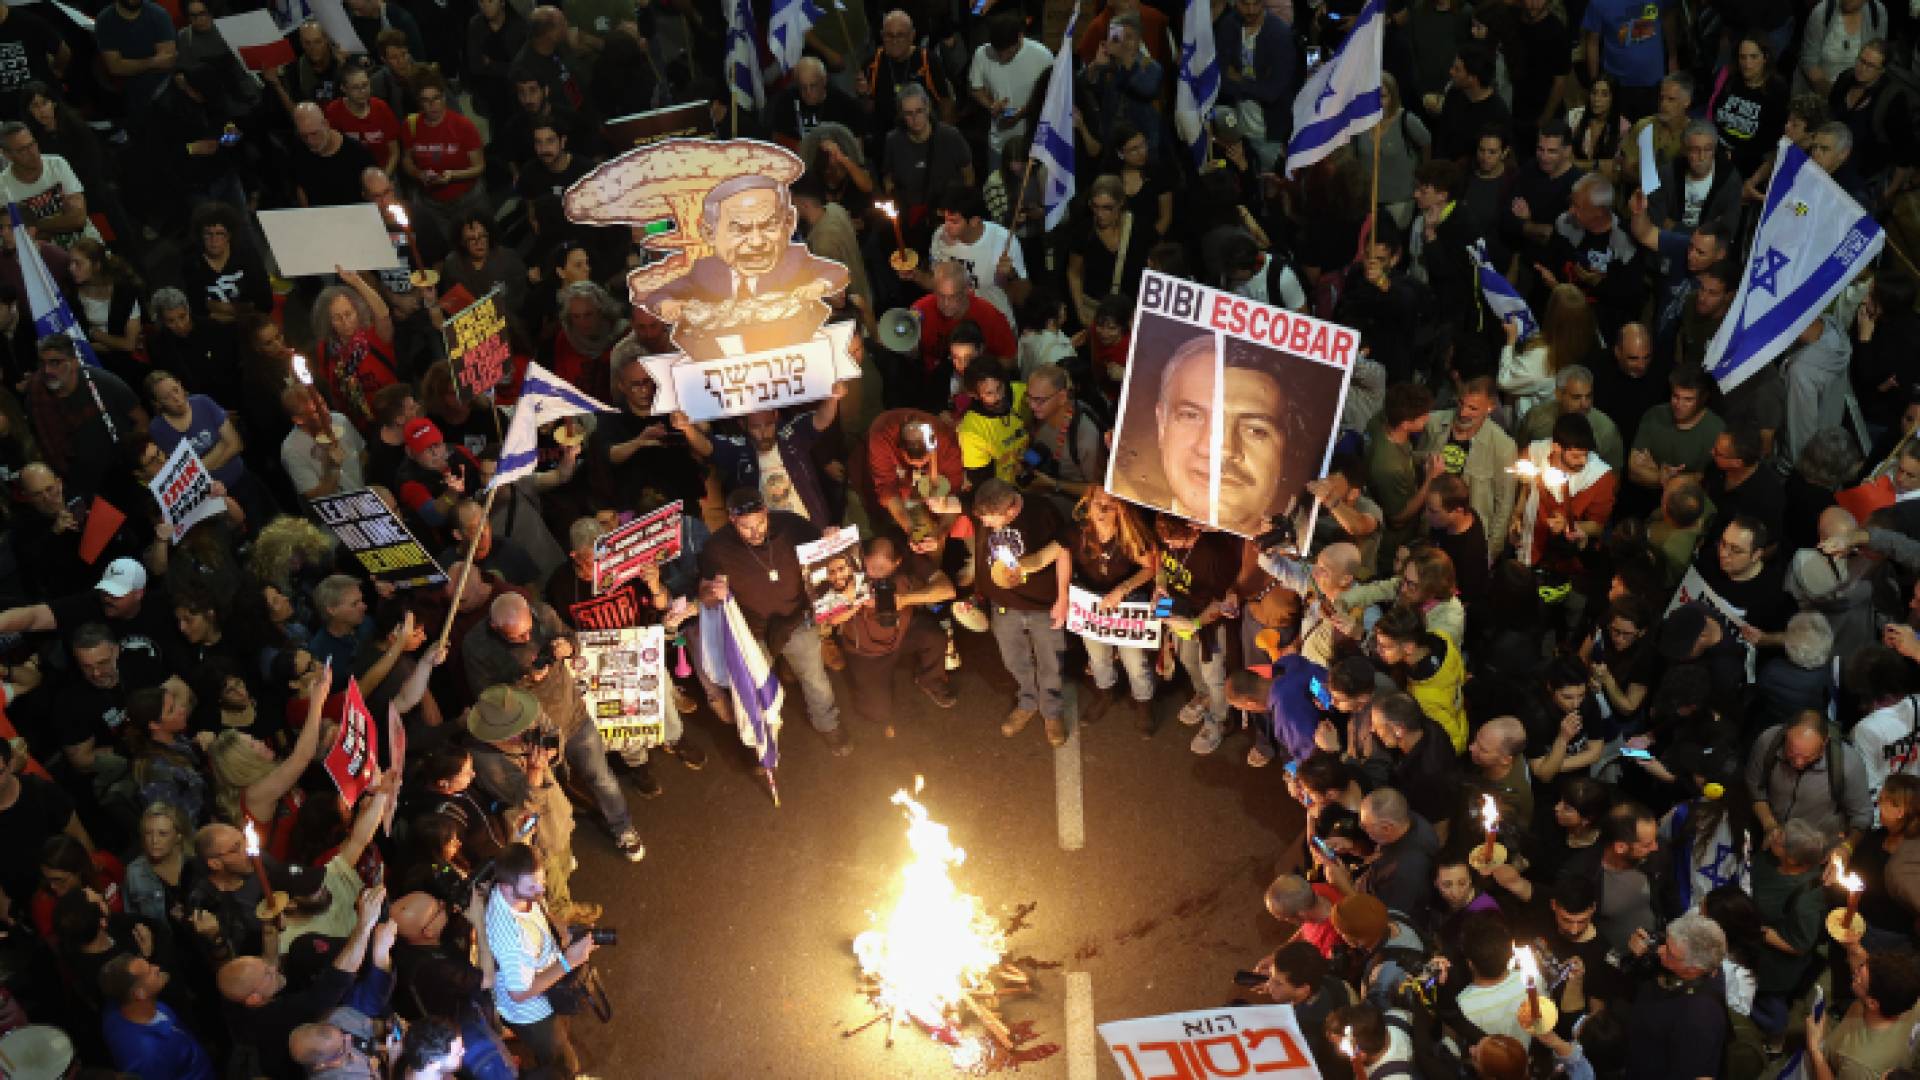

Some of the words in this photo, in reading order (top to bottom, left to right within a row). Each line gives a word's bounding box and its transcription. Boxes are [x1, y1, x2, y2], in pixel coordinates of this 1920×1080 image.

[1143, 275, 1206, 321] BIBI
[1210, 294, 1354, 365] ESCOBAR
[704, 354, 806, 389] מורשת
[710, 375, 806, 408] נתניהו
[162, 457, 199, 508] אותו
[1183, 1015, 1237, 1036] הוא
[1112, 1028, 1310, 1080] מסוכן
